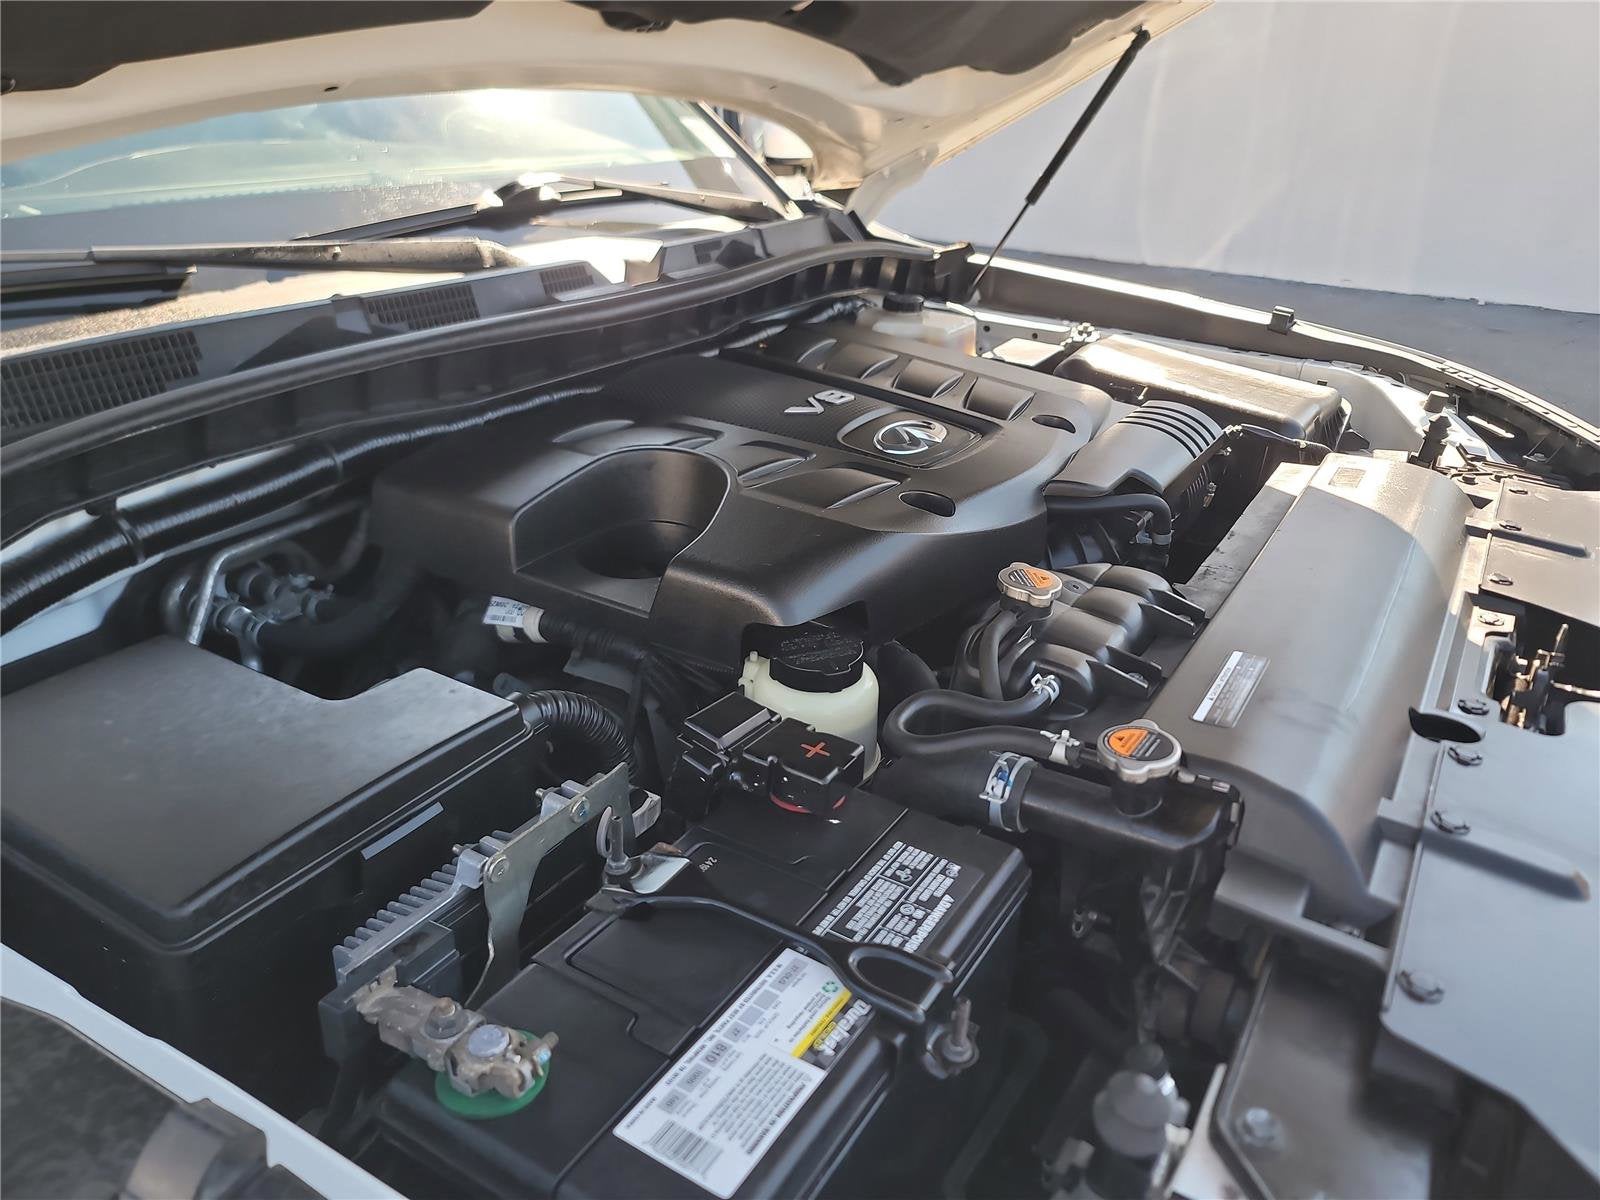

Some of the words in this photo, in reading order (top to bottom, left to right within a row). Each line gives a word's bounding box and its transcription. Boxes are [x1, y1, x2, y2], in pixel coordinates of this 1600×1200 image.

[784, 389, 856, 414] V8
[818, 997, 873, 1057] Duralast
[702, 1041, 728, 1064] 810
